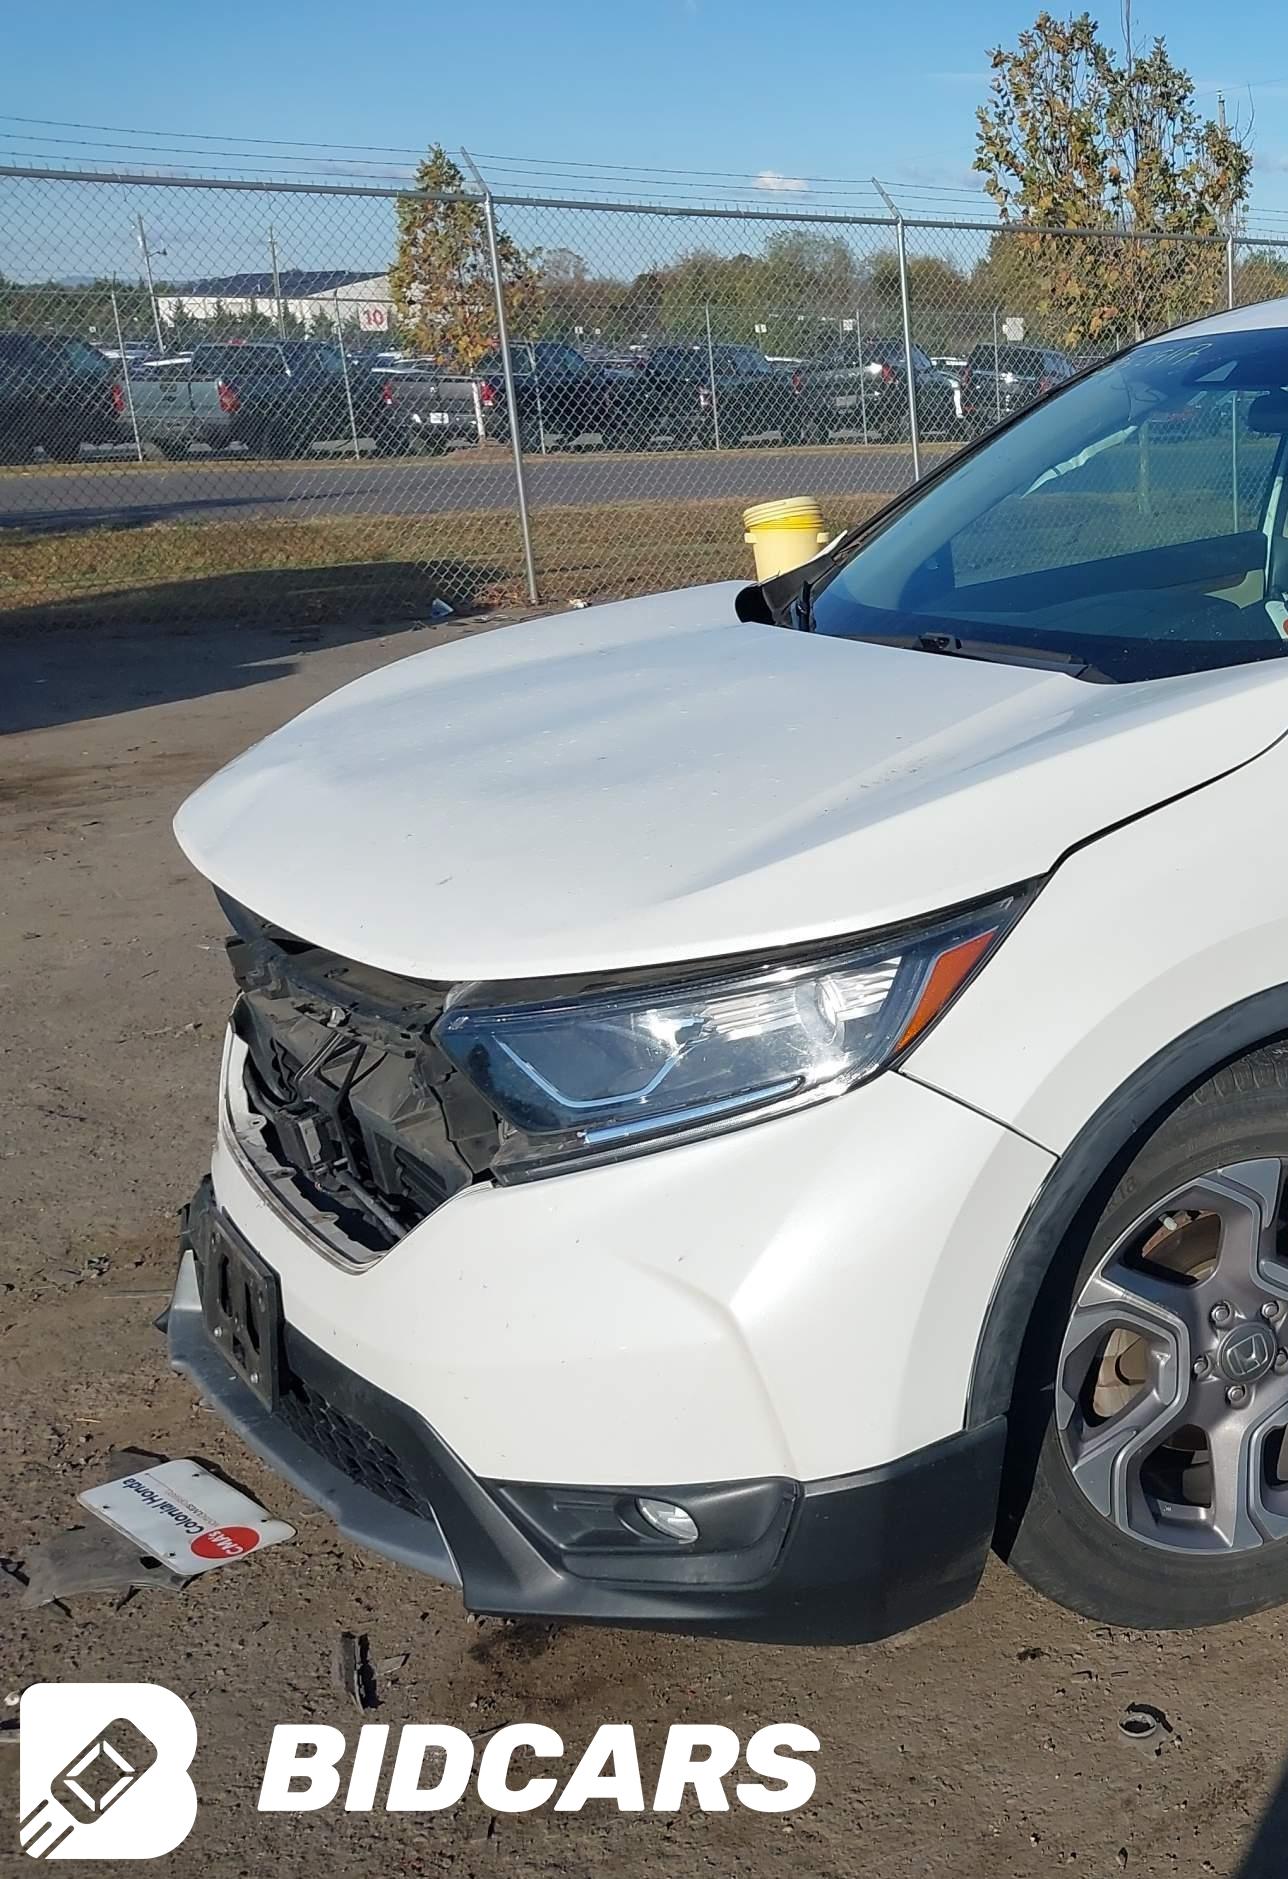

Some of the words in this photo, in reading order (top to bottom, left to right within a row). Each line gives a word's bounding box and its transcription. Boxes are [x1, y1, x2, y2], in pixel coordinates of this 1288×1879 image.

[122, 1477, 159, 1507] Honda
[153, 1498, 206, 1535] Colonial
[206, 1530, 245, 1556] CMA's
